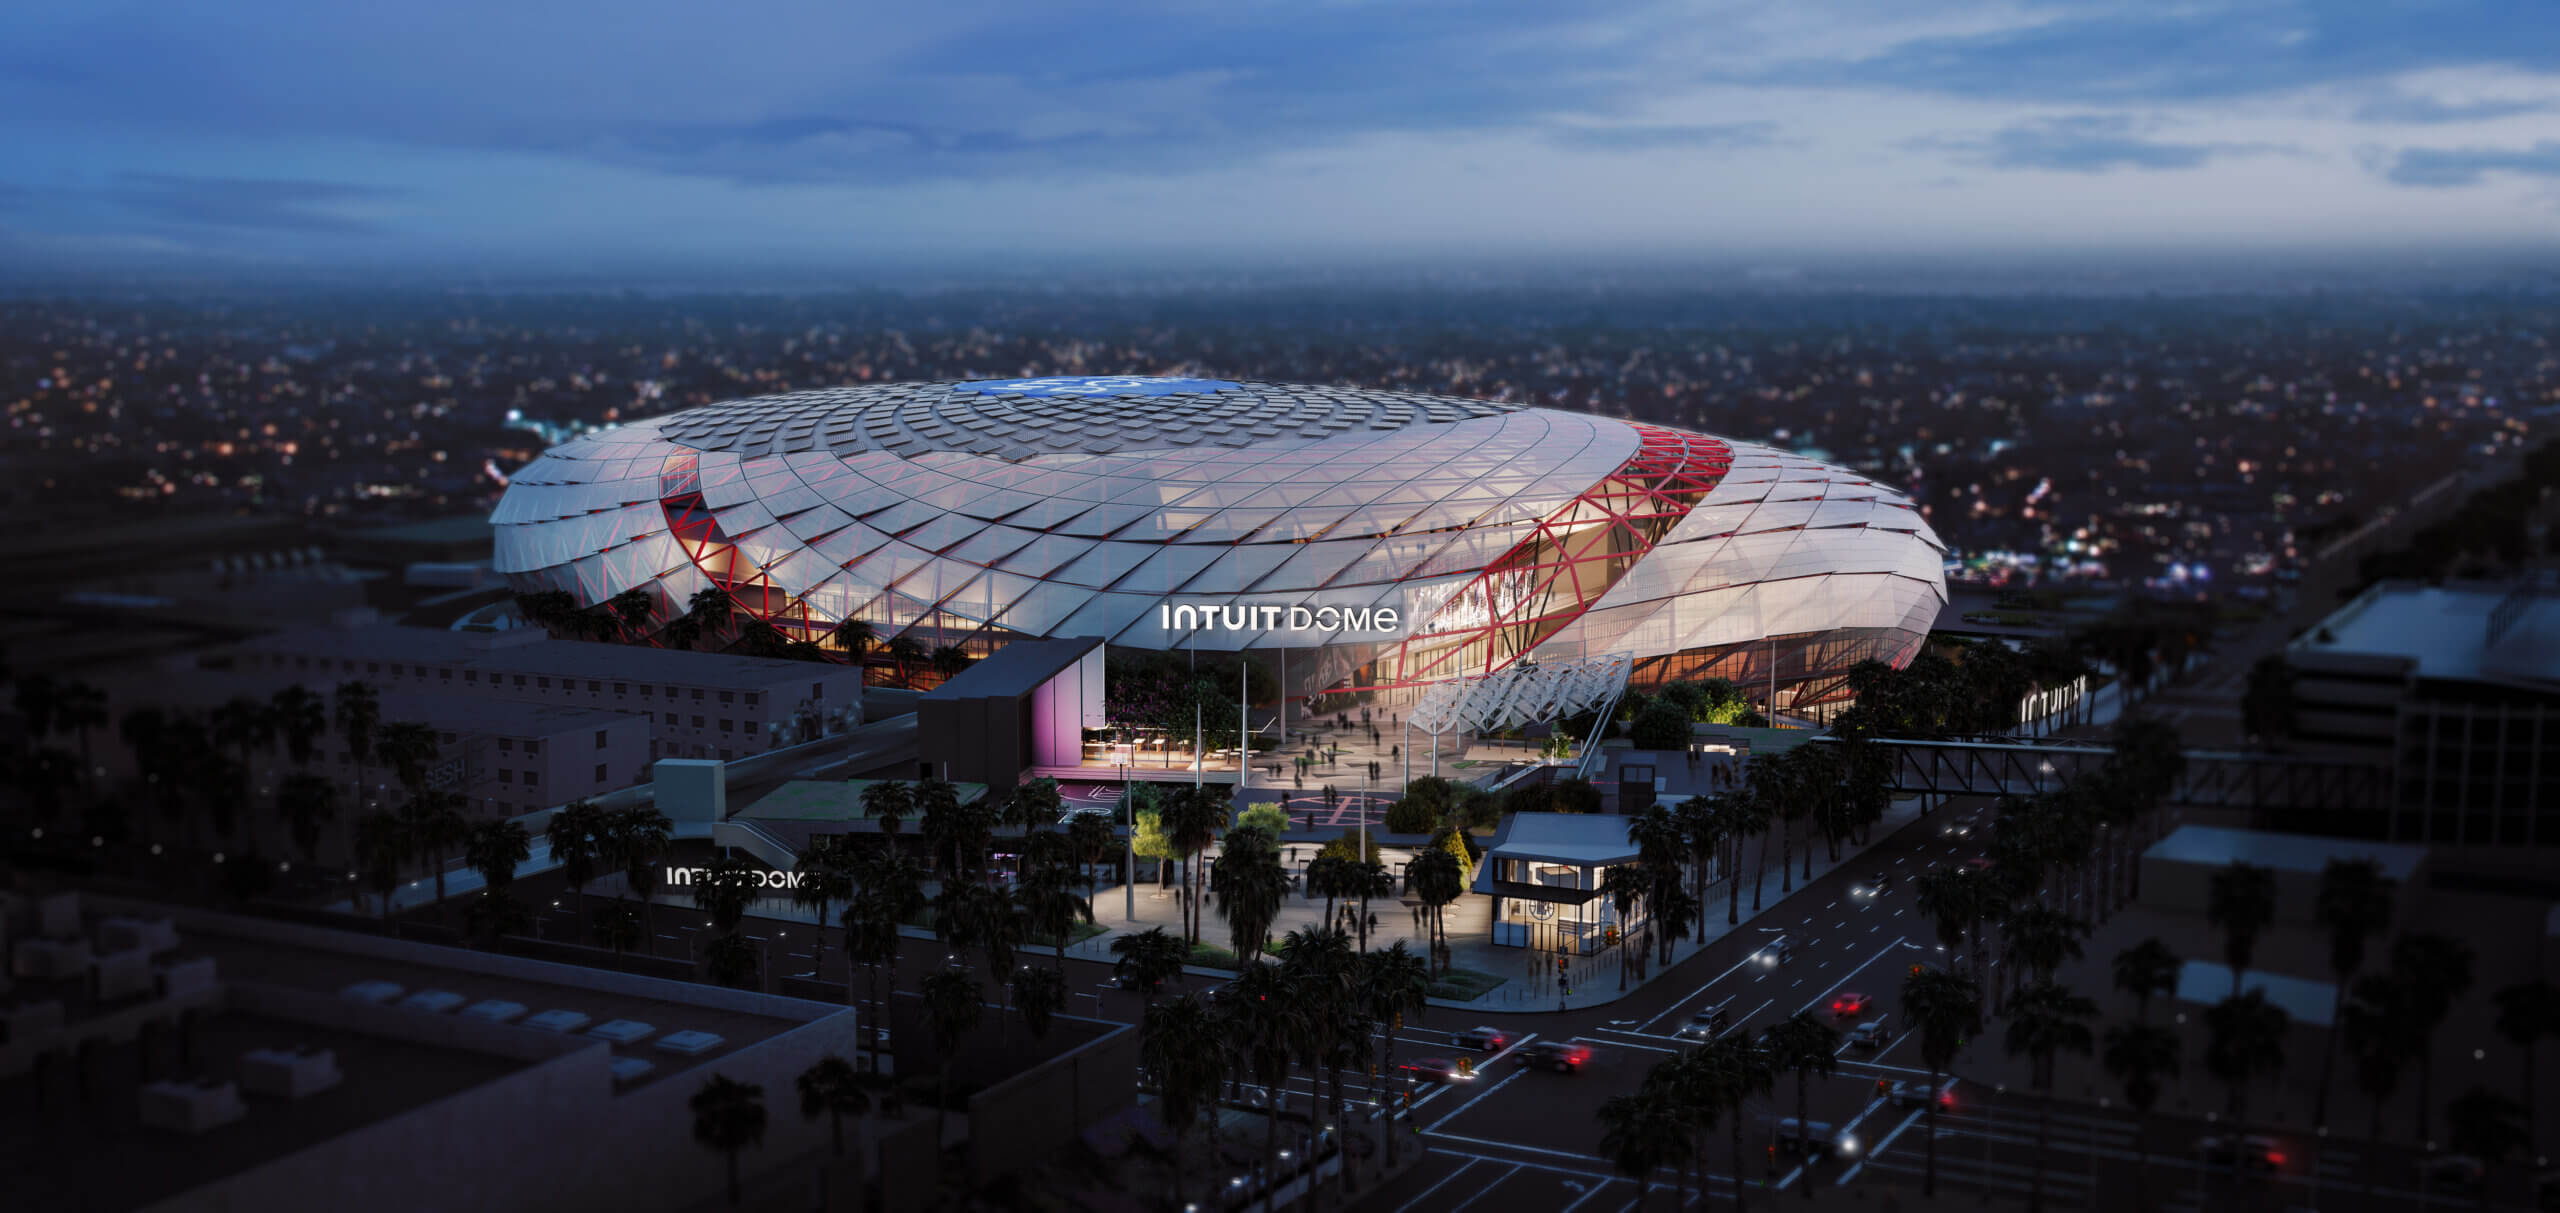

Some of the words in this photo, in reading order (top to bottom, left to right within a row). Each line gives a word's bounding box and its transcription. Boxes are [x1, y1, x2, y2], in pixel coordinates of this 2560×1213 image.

[1162, 605, 1282, 631] INTUIT
[1290, 606, 1399, 633] DOME
[666, 866, 746, 887] INT
[751, 870, 822, 889] DOM
